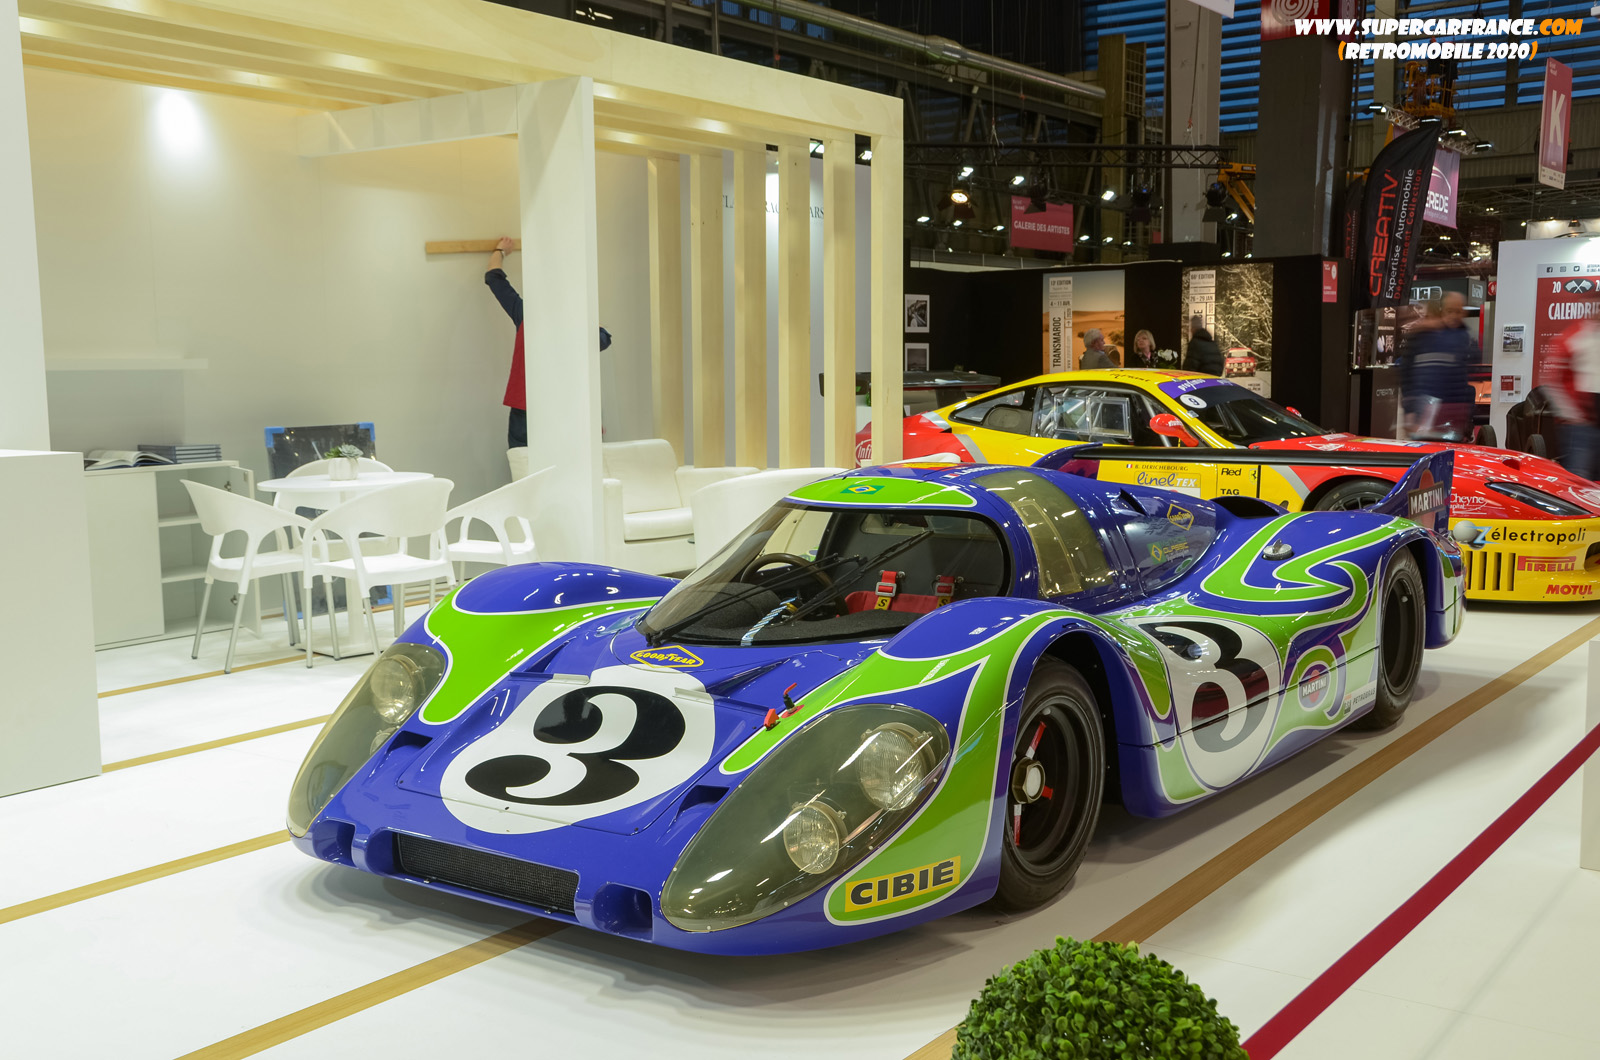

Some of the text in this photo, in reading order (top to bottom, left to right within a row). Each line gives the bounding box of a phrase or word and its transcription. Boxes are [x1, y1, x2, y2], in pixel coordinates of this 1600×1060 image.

[1549, 89, 1566, 147] K
[1405, 168, 1423, 226] Collection
[1013, 220, 1070, 235] GALERIE DES ARTISTES
[1385, 244, 1402, 300] Expertise
[1395, 168, 1415, 240] Automobile
[1552, 281, 1562, 293] 20
[1052, 316, 1062, 368] TRANSMAROC
[1141, 464, 1189, 472] DERICHEBOURG
[1221, 467, 1242, 476] Red
[1220, 488, 1240, 496] TAG
[1409, 486, 1444, 515] MARTINI
[1517, 555, 1577, 572] PIRELLI
[1545, 584, 1593, 595] MOTUL
[1138, 620, 1270, 753] 3
[1302, 676, 1327, 697] MARTINI
[464, 685, 687, 807] 3
